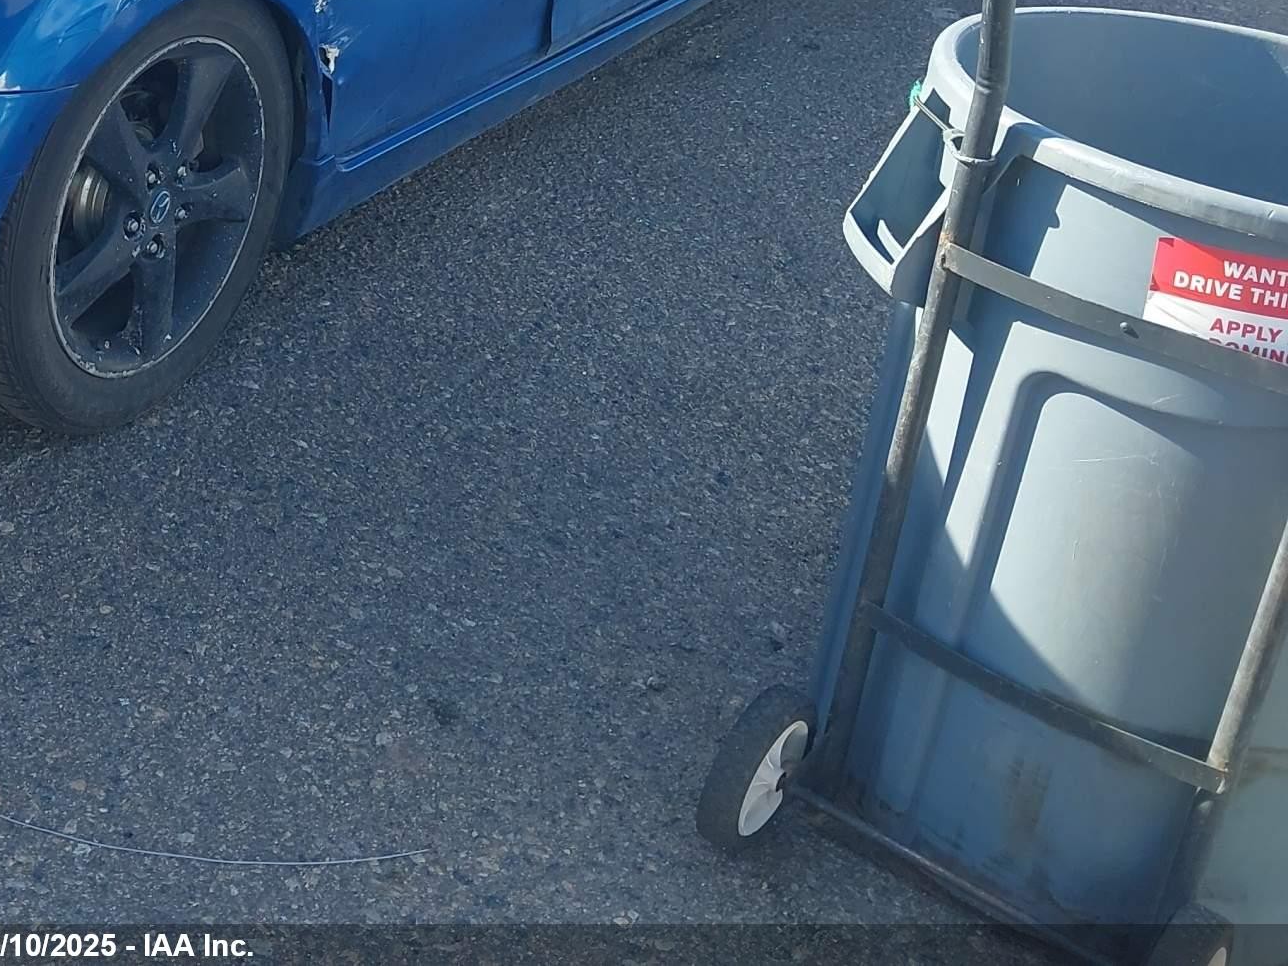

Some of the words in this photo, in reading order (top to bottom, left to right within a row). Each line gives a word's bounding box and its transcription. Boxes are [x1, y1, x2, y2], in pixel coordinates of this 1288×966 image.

[1223, 260, 1288, 287] WANT
[1173, 271, 1242, 300] DRIVE
[1250, 287, 1288, 309] THI
[1209, 318, 1283, 343] APPLY
